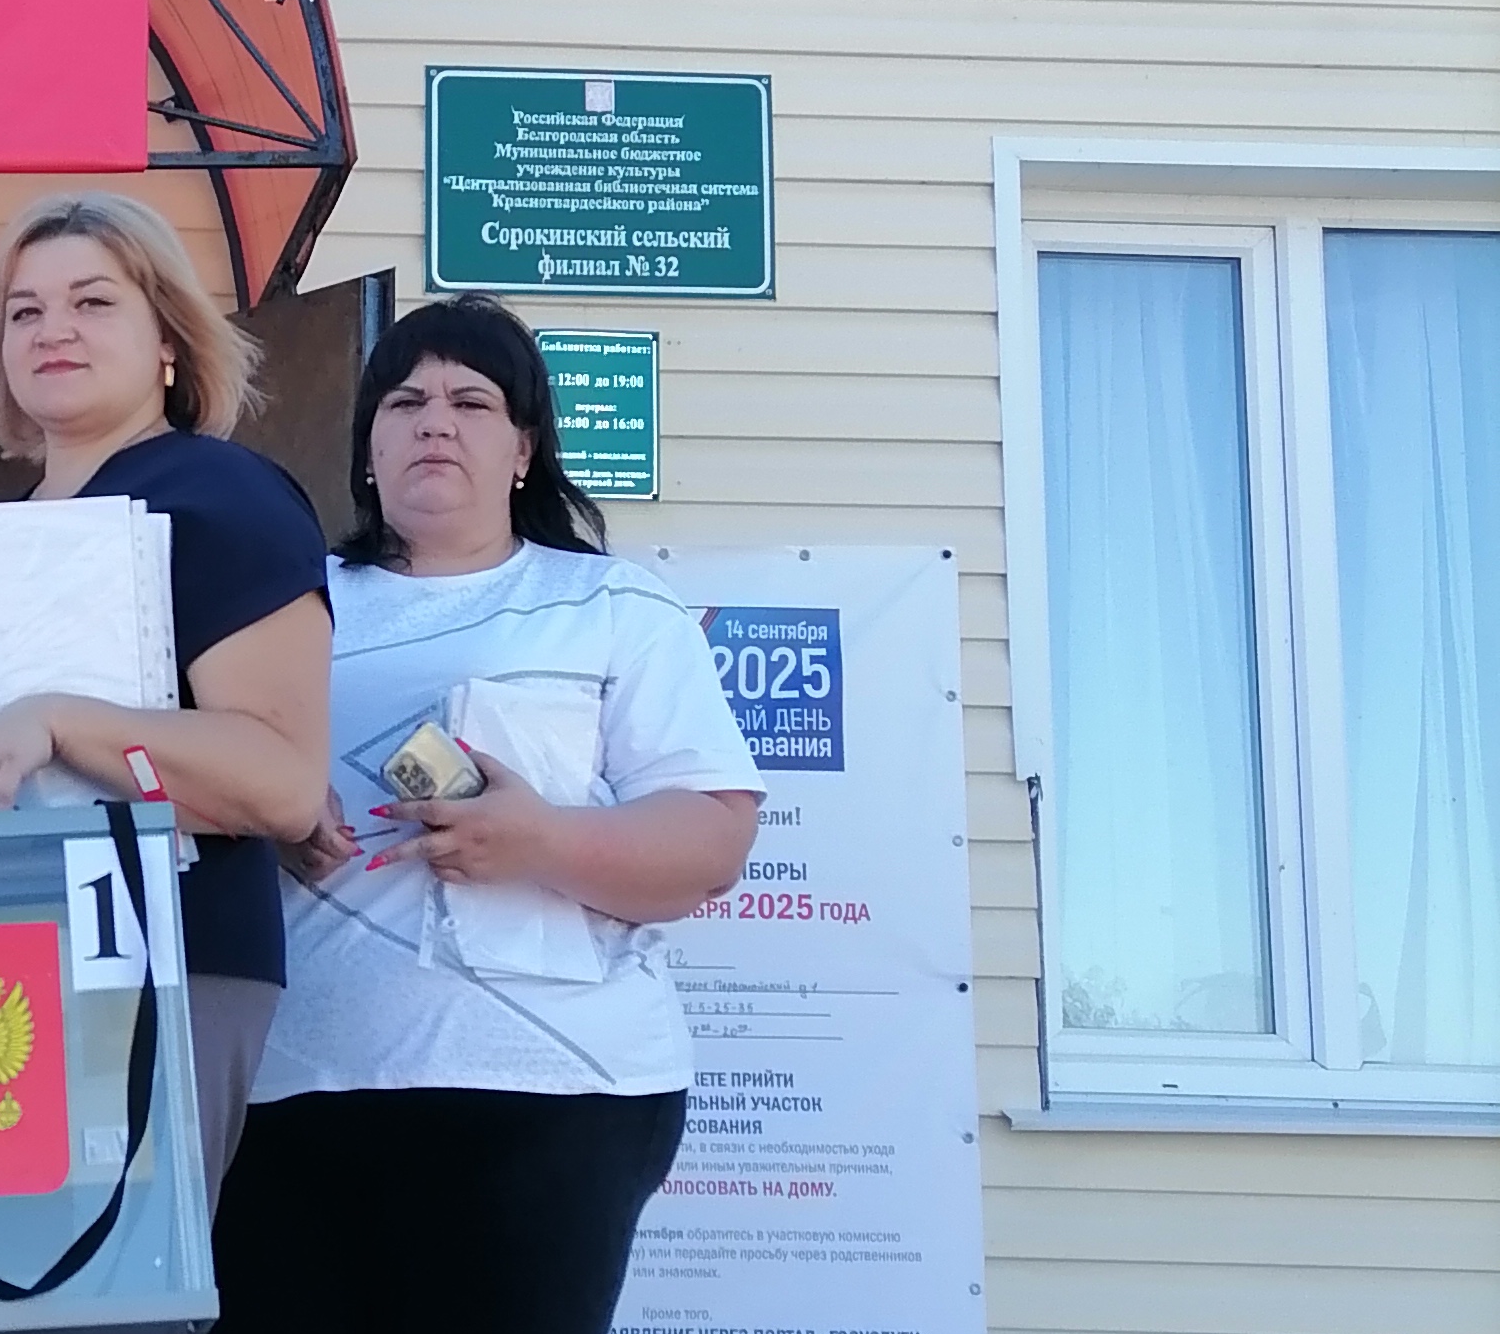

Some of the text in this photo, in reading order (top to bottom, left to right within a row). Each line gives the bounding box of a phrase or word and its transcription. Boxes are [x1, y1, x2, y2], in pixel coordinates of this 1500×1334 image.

[513, 110, 684, 130] Российская Федерация
[516, 127, 680, 145] Белгородская область
[494, 143, 702, 162] Муниципальное бюджетное
[516, 164, 681, 180] учреждение культуры
[594, 179, 698, 195] библиотечная
[701, 183, 759, 196] система
[481, 220, 731, 250] Сорокинский сельский
[538, 253, 679, 281] филиал № 32
[558, 373, 590, 387] 12:00
[594, 377, 610, 387] до
[613, 375, 644, 388] 19:00
[593, 420, 609, 430] до
[613, 418, 644, 430] 16:00
[725, 619, 828, 644] 14 сентября
[711, 645, 831, 699] 2025
[774, 708, 831, 733] ДЕНЬ
[747, 737, 832, 757] ования
[758, 807, 801, 825] ели!
[743, 862, 807, 881] БОРЫ
[78, 872, 132, 961] 1
[738, 892, 813, 920] 2025
[820, 902, 871, 924] ГОДА
[731, 1070, 794, 1088] ПРИЙТИ
[686, 1093, 823, 1112] ЛЬНЫЙ УЧАСТОК
[686, 1119, 762, 1134] СОВАНИЯ
[700, 1143, 706, 1153] в
[710, 1143, 745, 1154] связи
[748, 1144, 755, 1153] с
[759, 1141, 859, 1156] необходимостью
[862, 1144, 895, 1157] ухода
[702, 1162, 735, 1172] иным
[738, 1162, 826, 1175] уважительным
[829, 1163, 893, 1175] причинам,
[661, 1180, 837, 1199] ОЛОСОВАТЬ НА ДОМУ.
[687, 1229, 753, 1242] обратитесь
[757, 1230, 763, 1240] в
[766, 1230, 835, 1244] участковую
[839, 1231, 901, 1242] комиссию
[650, 1248, 671, 1258] или
[675, 1247, 736, 1261] передайте
[740, 1248, 788, 1262] просьбу
[791, 1250, 827, 1262] через
[831, 1250, 922, 1263] родственников
[633, 1268, 721, 1278] или знакомых.
[642, 1307, 713, 1321] Кроме того,
